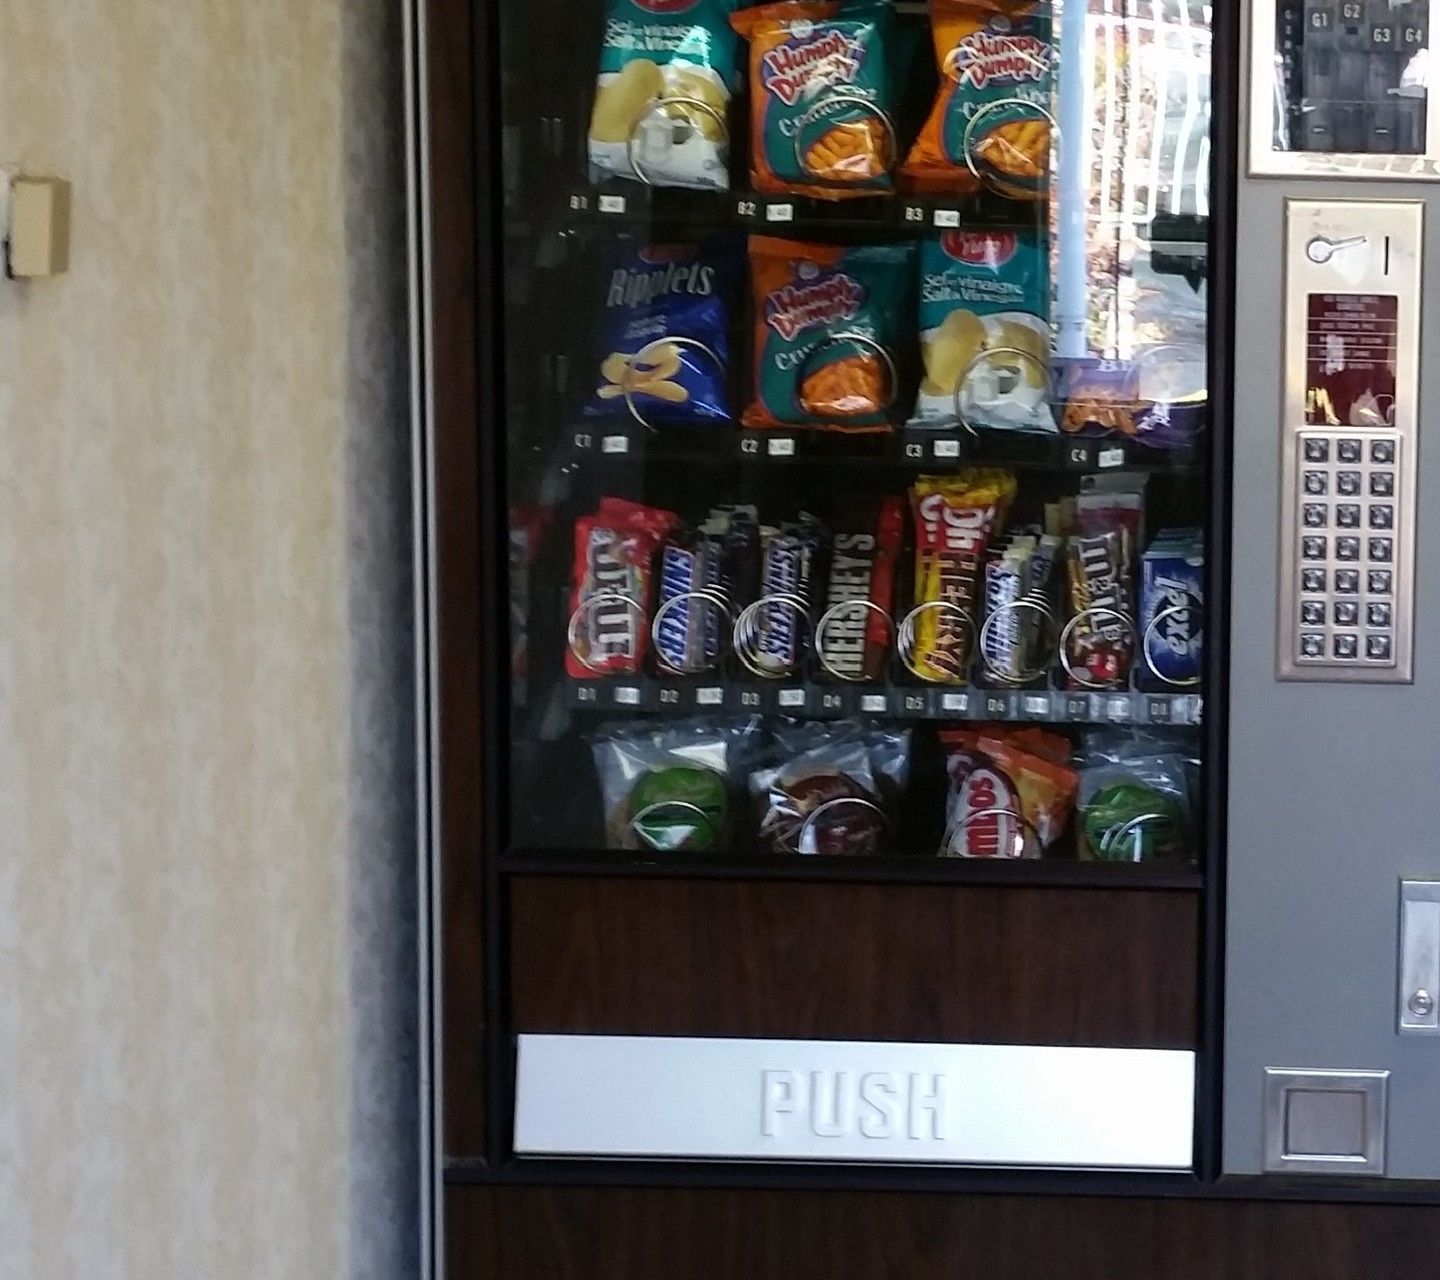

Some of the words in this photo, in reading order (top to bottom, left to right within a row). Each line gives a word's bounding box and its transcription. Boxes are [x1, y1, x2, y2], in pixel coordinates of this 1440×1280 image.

[1343, 3, 1361, 19] G2
[1311, 12, 1328, 28] G1
[1373, 28, 1391, 43] G3
[1405, 28, 1423, 43] G4
[737, 200, 757, 216] B2
[904, 206, 925, 222] B3
[606, 261, 715, 308] Ripplets
[740, 438, 760, 454] C2
[905, 443, 924, 458] C3
[1071, 448, 1088, 463] C4
[823, 533, 876, 673] HERSHEY'S
[1154, 576, 1191, 656] excel
[760, 1070, 946, 1140] PUSH
